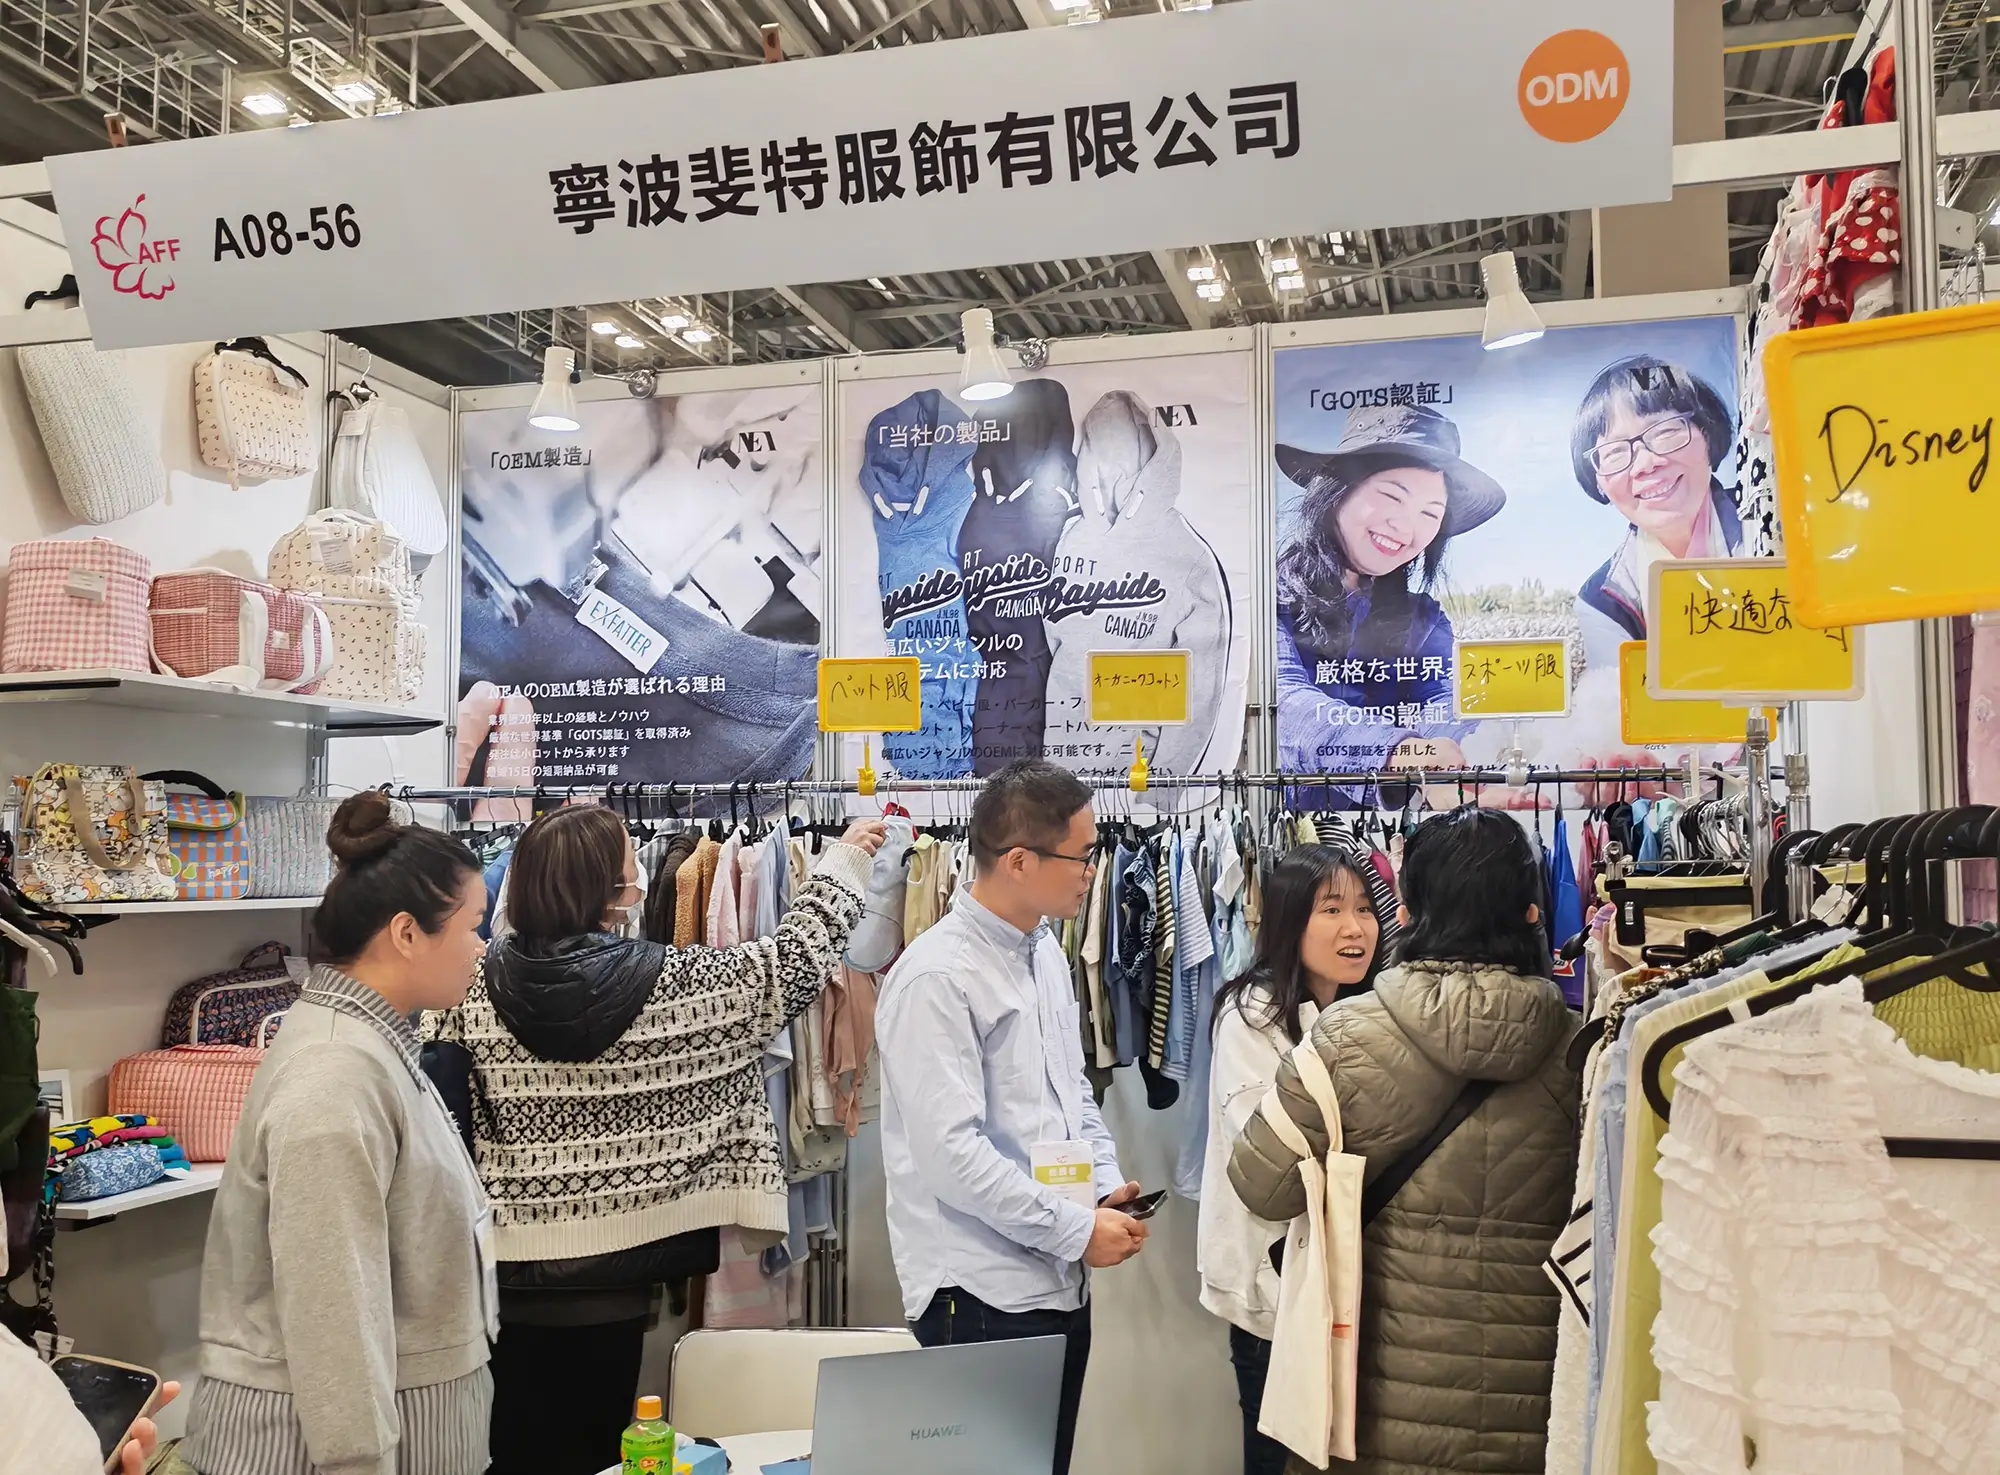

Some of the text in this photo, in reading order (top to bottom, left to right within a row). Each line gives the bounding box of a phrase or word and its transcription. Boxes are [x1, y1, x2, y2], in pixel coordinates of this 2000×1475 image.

[1526, 67, 1619, 107] ODM
[549, 80, 1302, 236] 寧波斐特服飾有限公司
[212, 203, 363, 263] A08-56
[137, 237, 182, 265] AFF
[1310, 381, 1454, 411] 「GOTS認証」
[879, 419, 1011, 448] 「当社の製品」
[490, 446, 592, 471] 「OEM製造」
[1818, 404, 1993, 504] Disney
[1052, 555, 1098, 576] PORT
[994, 596, 1043, 619] CANADA
[1042, 570, 1168, 625] Bayside
[905, 619, 962, 639] CANADA
[1104, 614, 1156, 640] CANADA
[919, 660, 1007, 682] テムに対応
